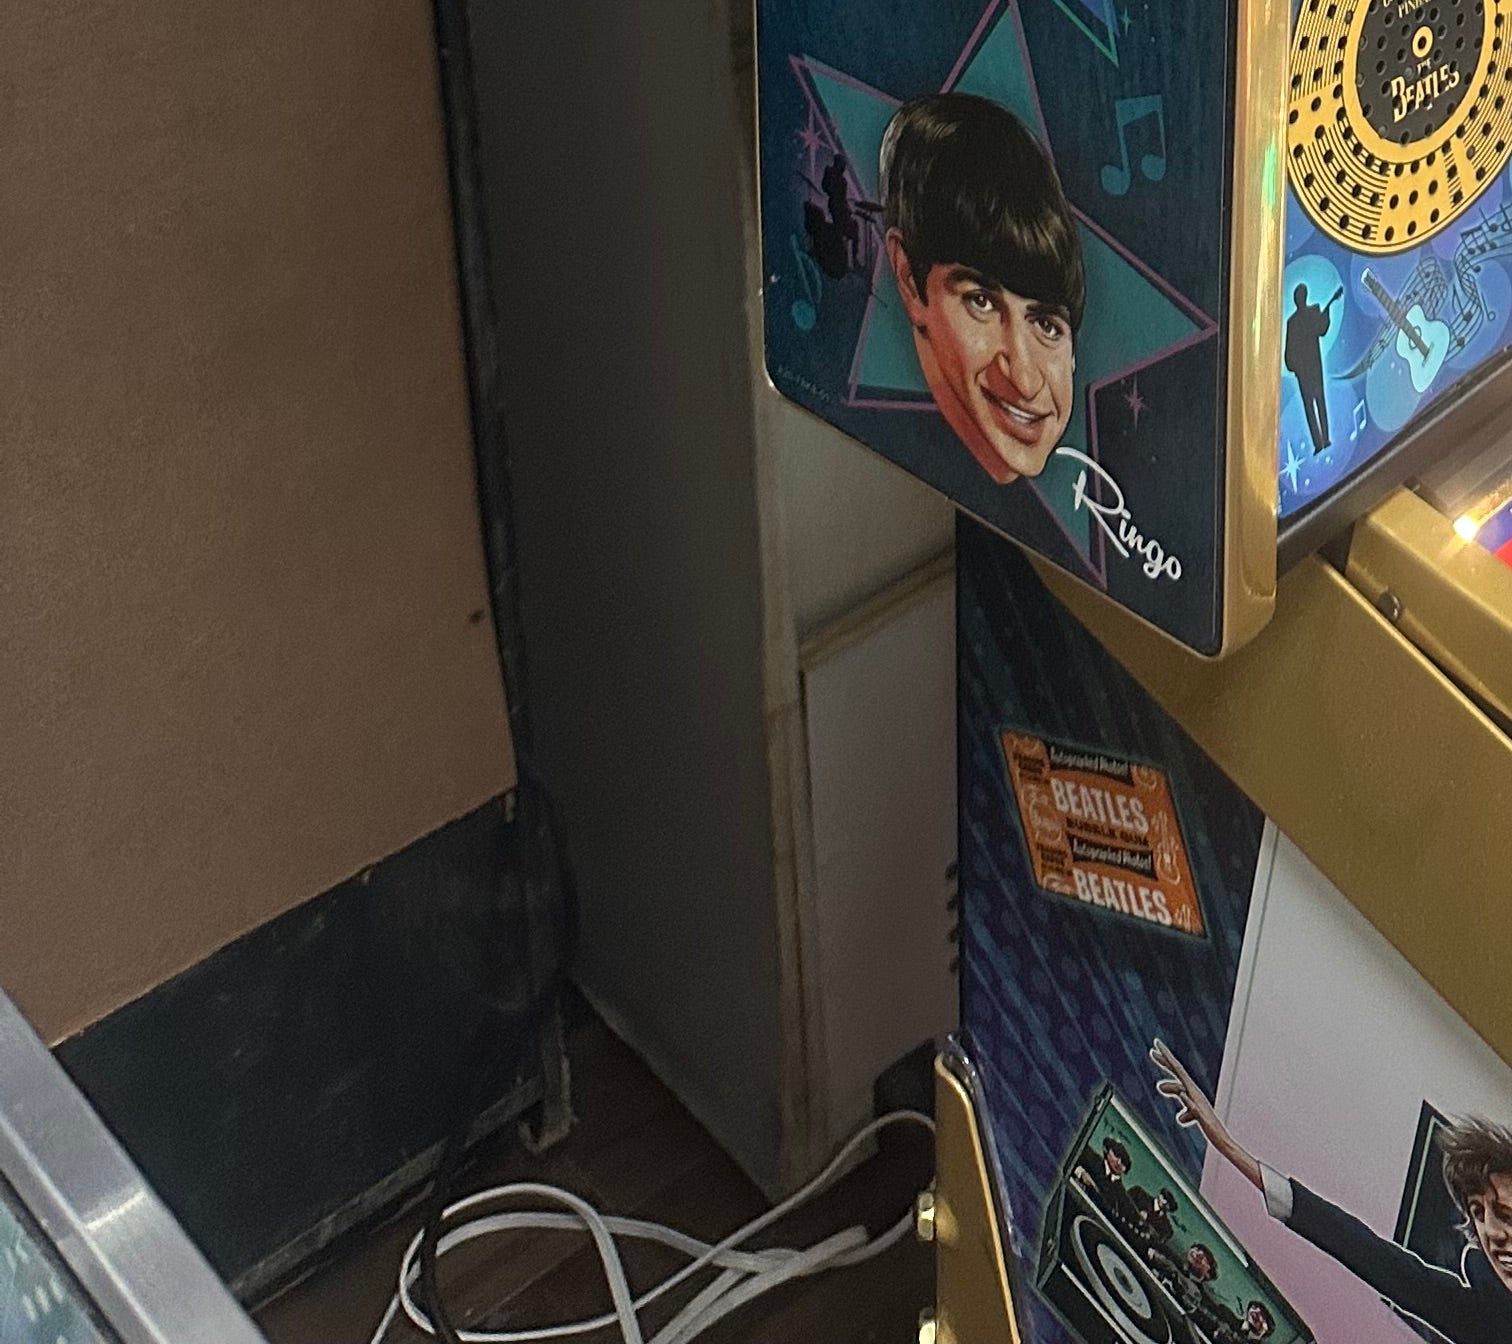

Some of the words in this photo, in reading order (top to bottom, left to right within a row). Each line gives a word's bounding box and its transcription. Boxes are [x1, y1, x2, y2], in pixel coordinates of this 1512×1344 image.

[1391, 64, 1460, 123] BEATLES
[1055, 445, 1185, 582] Ringo
[1051, 777, 1149, 834] BEATLES
[1072, 868, 1173, 927] BEATLES
